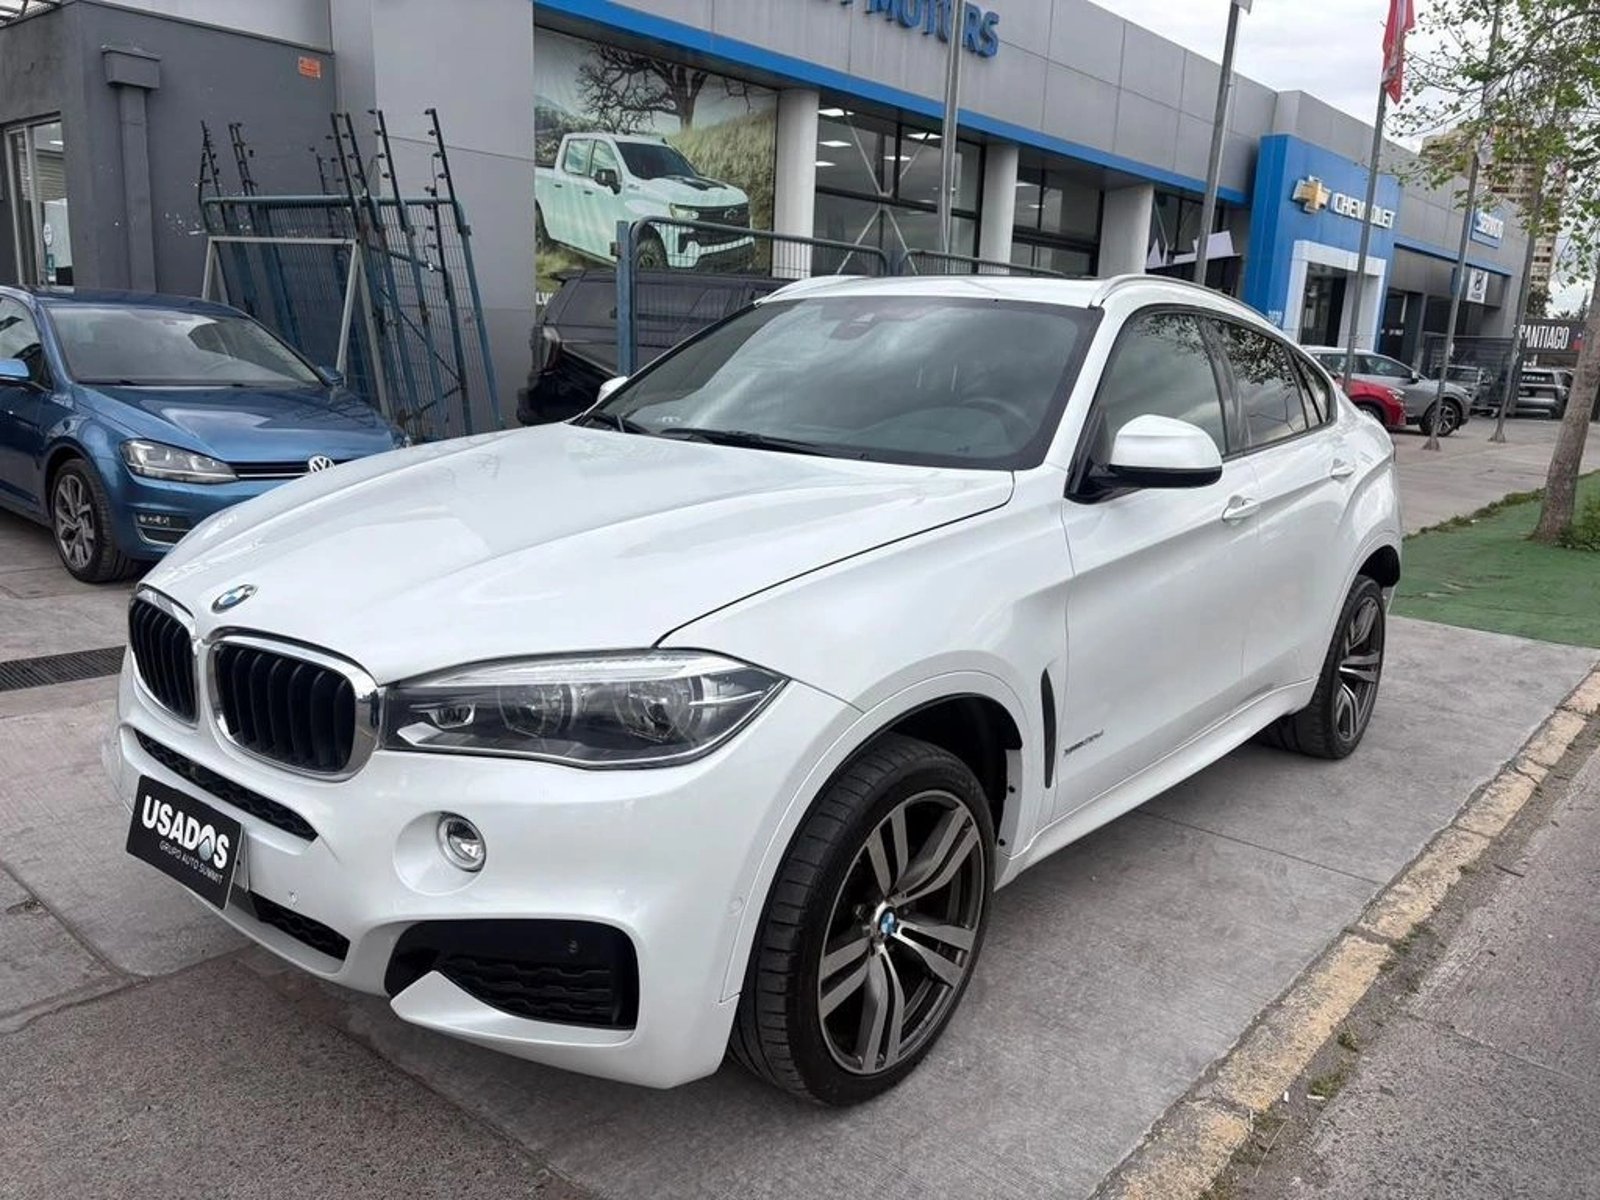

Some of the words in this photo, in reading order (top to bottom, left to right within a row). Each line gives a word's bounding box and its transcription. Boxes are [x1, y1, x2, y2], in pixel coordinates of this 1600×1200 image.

[1331, 192, 1395, 229] CHEVOLET
[142, 795, 229, 869] USADOS
[159, 840, 182, 859] GRUPO
[182, 853, 199, 870] AUTO
